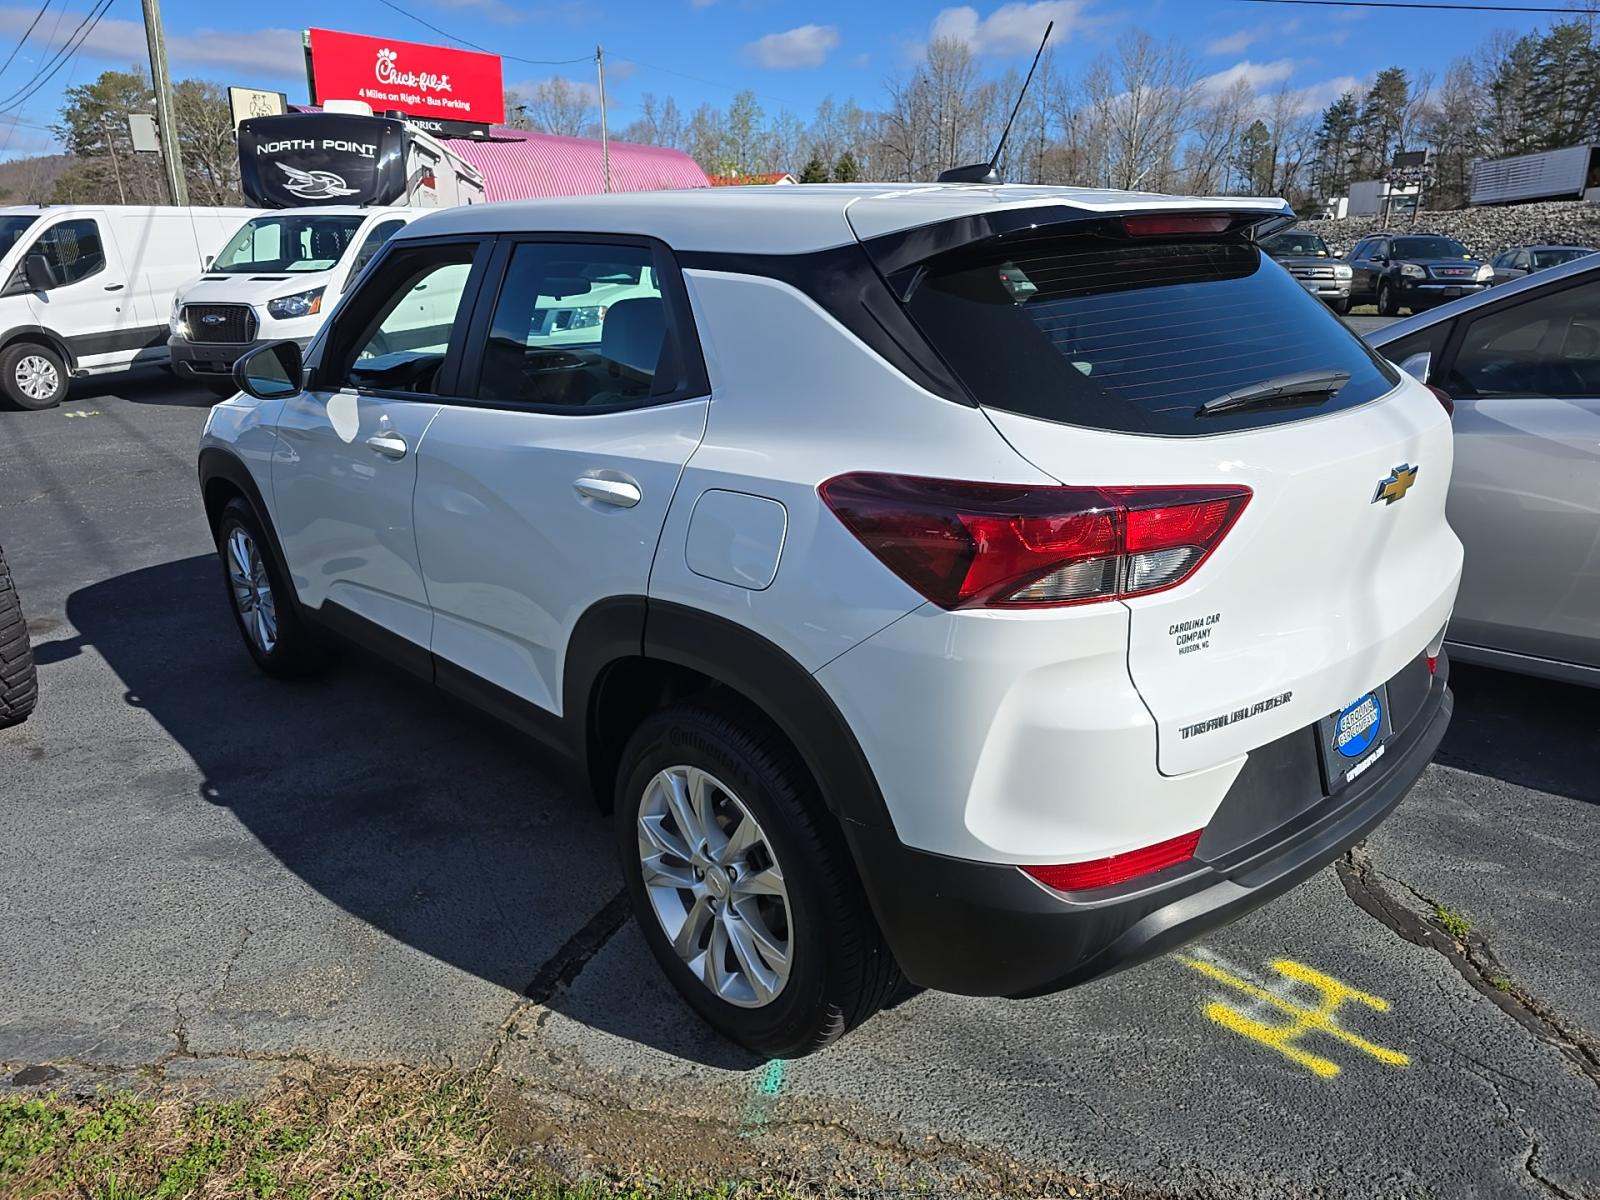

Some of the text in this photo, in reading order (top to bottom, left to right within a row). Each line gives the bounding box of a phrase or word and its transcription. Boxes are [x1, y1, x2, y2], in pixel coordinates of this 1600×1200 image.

[375, 48, 452, 92] Chick-fil-A
[358, 88, 366, 97] 4
[366, 89, 387, 100] Miles
[400, 93, 421, 105] Right
[427, 96, 441, 106] Bus
[442, 98, 471, 112] Parking
[408, 119, 442, 132] DRICK
[257, 139, 377, 155] NORTH POINT
[1169, 613, 1221, 636] CAROLINA CAR
[1176, 628, 1212, 646] COMPANY
[1179, 691, 1293, 740] TRAILBLAZER
[1340, 699, 1374, 732] CAROLINA
